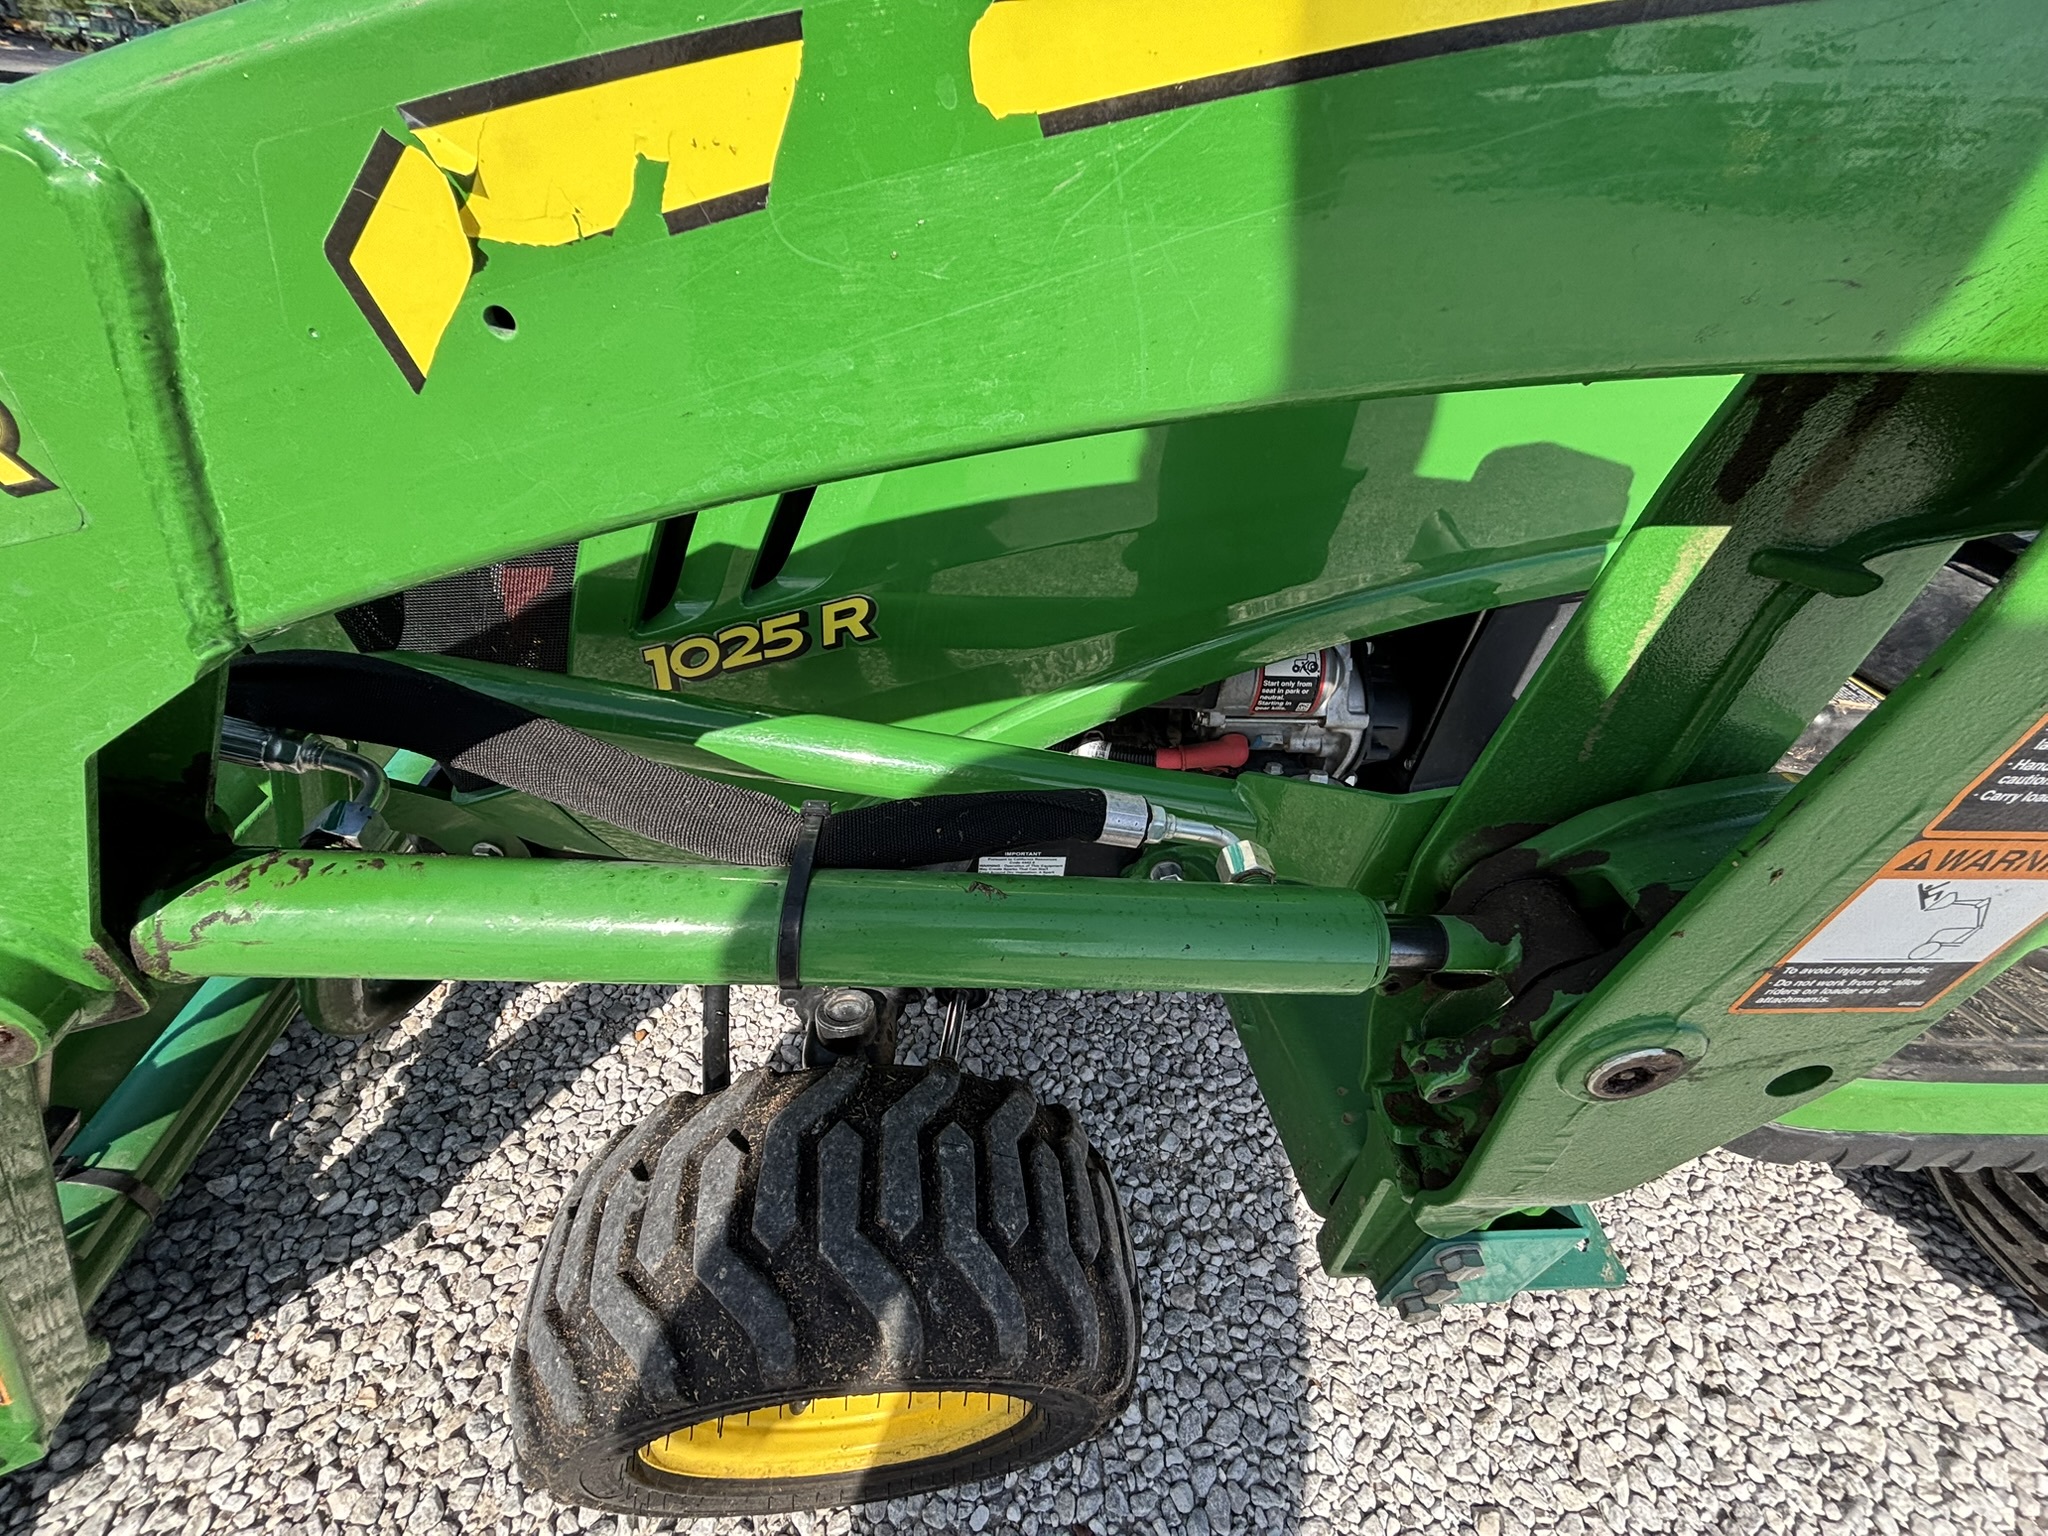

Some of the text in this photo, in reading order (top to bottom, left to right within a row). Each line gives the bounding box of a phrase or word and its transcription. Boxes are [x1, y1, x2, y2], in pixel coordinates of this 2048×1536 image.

[643, 595, 880, 692] 1025 R
[1263, 679, 1280, 687] Start
[1280, 680, 1296, 688] only
[1979, 790, 2024, 804] Carry
[1782, 966, 1799, 974] To
[1799, 966, 1836, 974] avoid
[1835, 966, 1873, 975] injury
[1872, 966, 1903, 974] from
[1755, 996, 1830, 1004] attachments.
